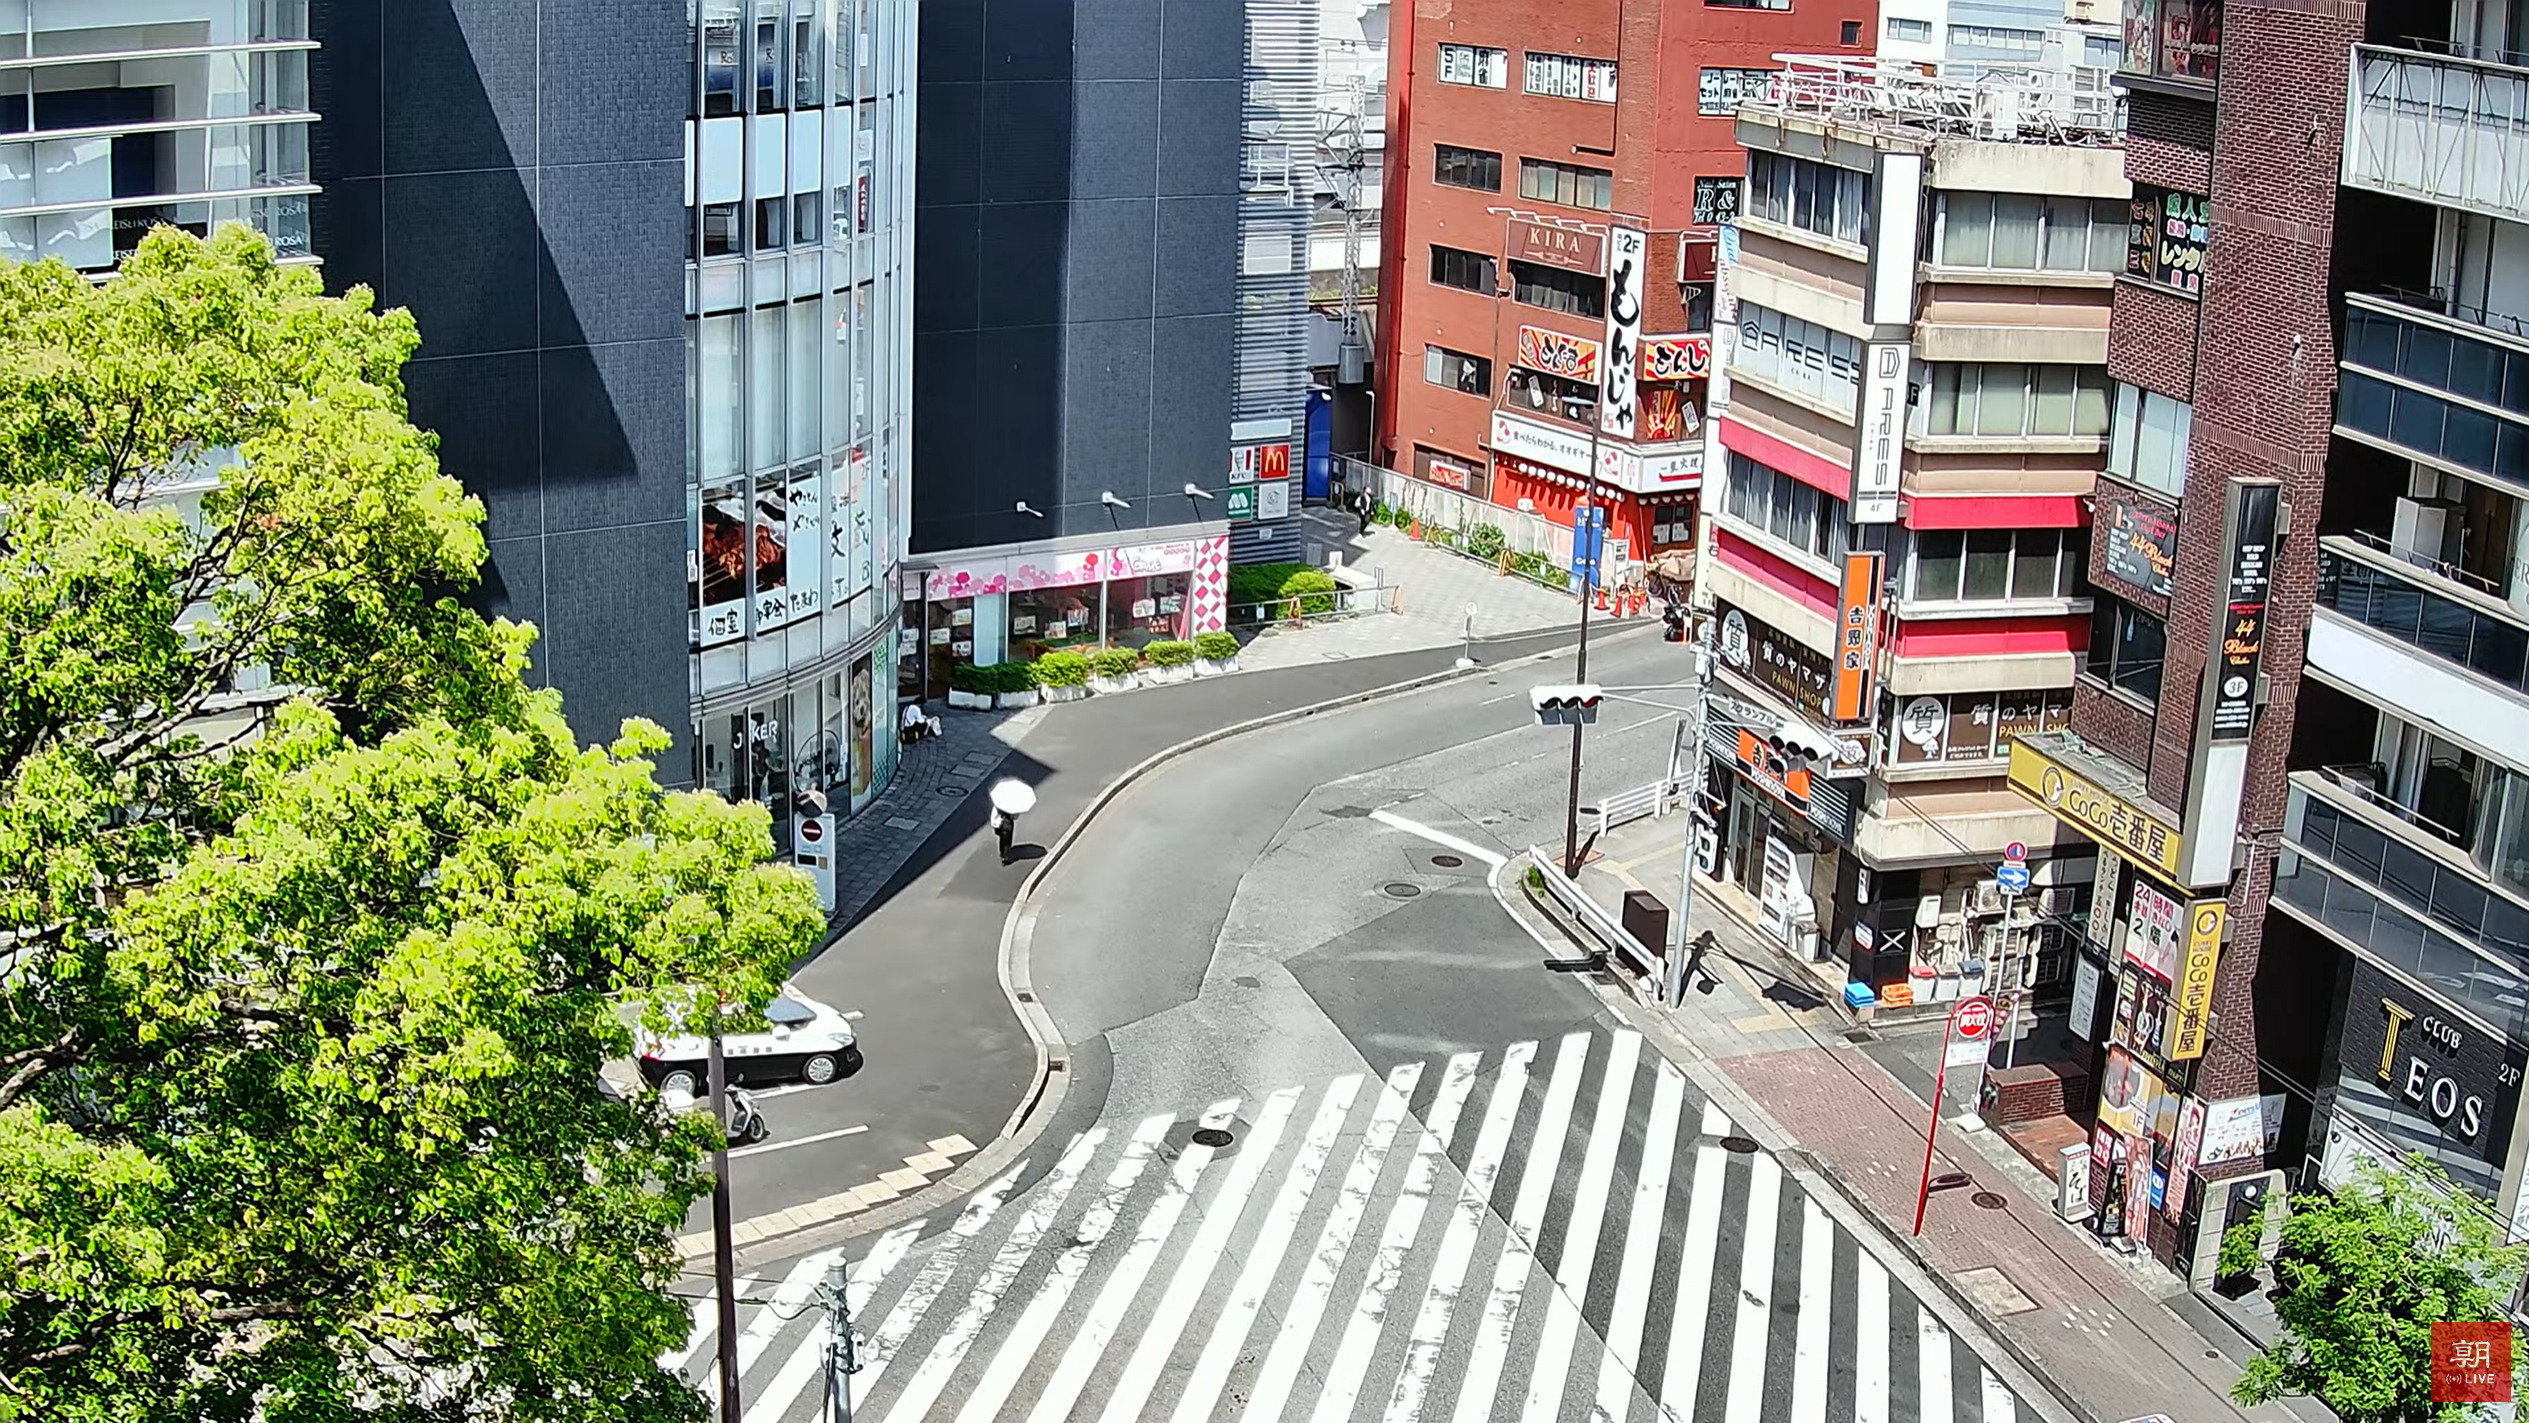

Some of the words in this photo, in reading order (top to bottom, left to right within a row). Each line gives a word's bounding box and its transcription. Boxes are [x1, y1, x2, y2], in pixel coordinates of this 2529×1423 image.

[1530, 227, 1580, 253] KIRA
[1623, 234, 1640, 254] 2F
[1610, 259, 1640, 430] もんじゃ
[1727, 619, 1745, 656] 質
[1845, 606, 1864, 670] 吉野家
[2224, 640, 2259, 655] Black
[1772, 670, 1796, 695] PAWN
[2229, 681, 2244, 693] 3F
[1910, 704, 1939, 735] 質
[1999, 724, 2038, 739] PAWN
[733, 719, 779, 750] JKER
[2069, 789, 2167, 863] CoCo壱番屋
[2422, 1016, 2462, 1049] CLUB
[2498, 1064, 2520, 1088] 2F
